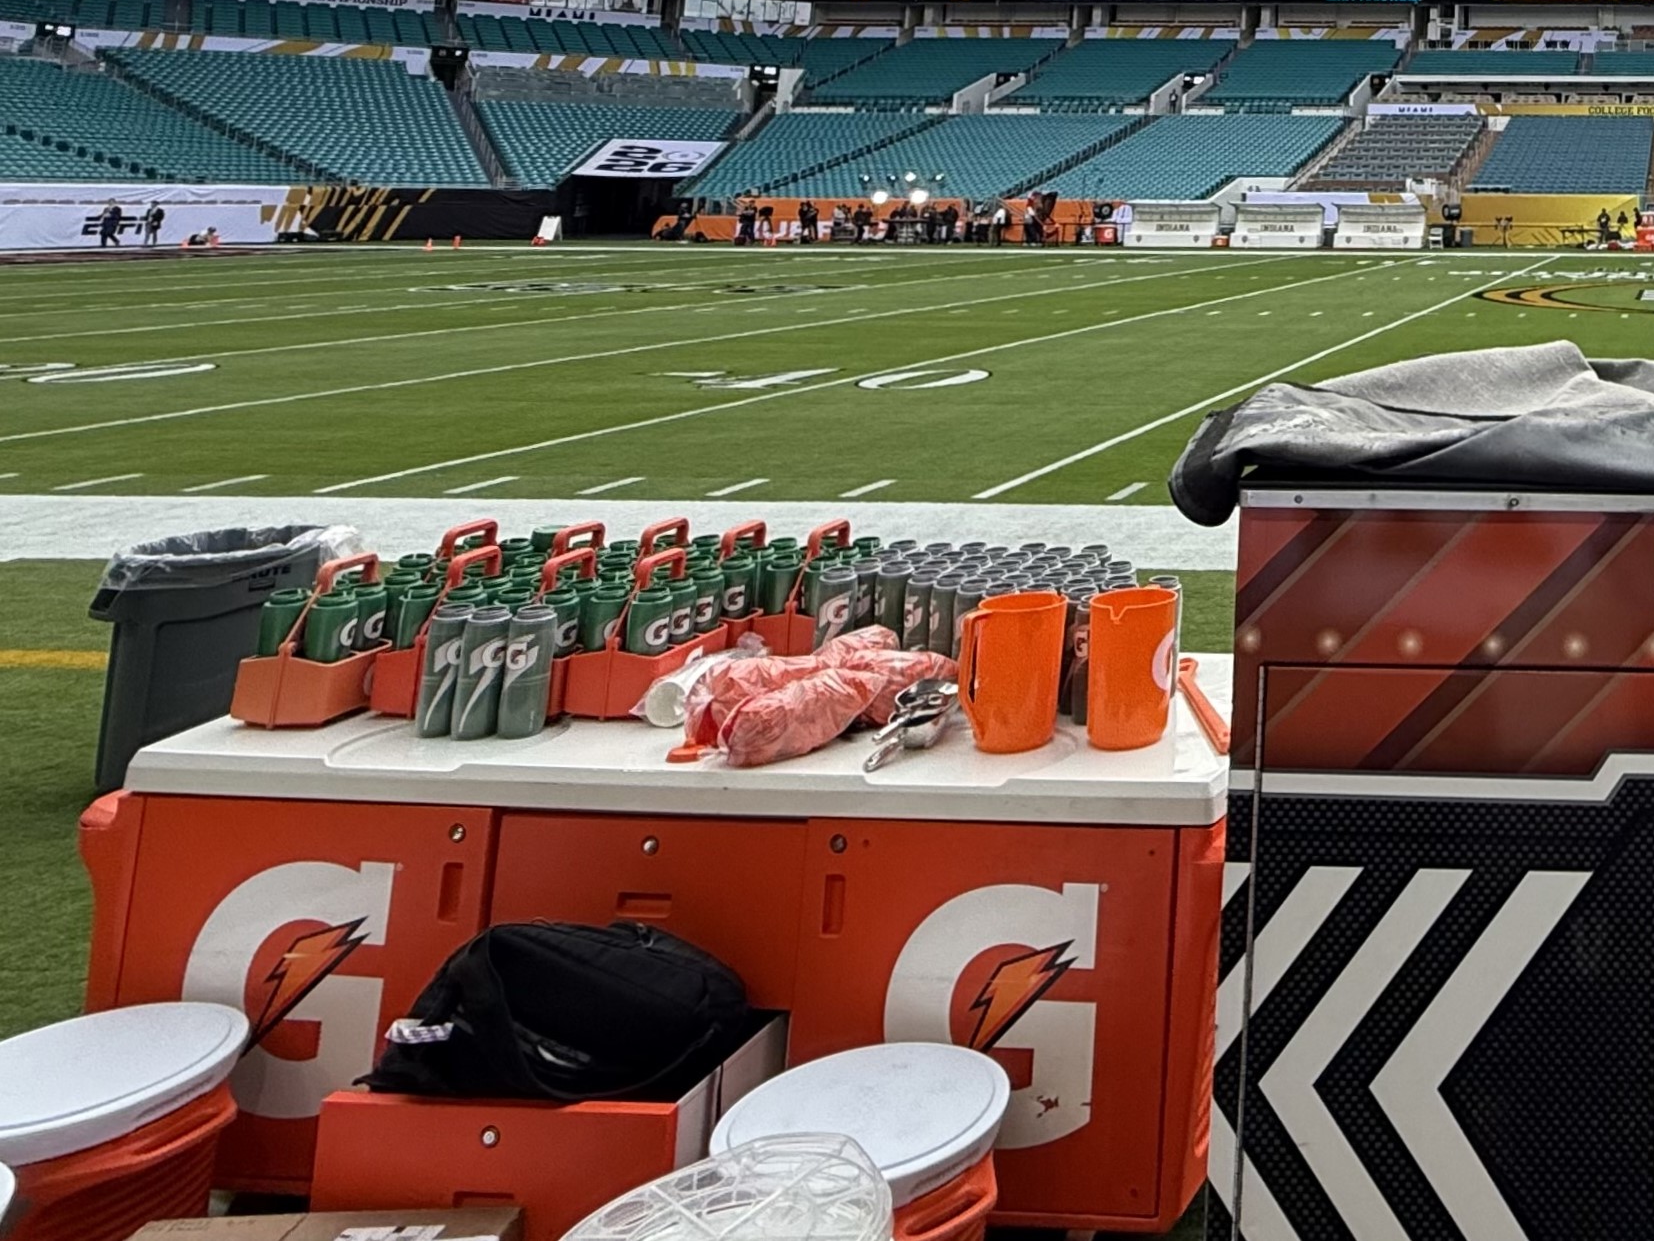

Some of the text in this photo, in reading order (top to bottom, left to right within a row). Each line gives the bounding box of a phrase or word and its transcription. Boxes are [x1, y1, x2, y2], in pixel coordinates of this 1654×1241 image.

[1588, 105, 1633, 118] COLLEGE
[1155, 223, 1191, 233] INDIANA
[1260, 223, 1296, 234] INDIANA
[1362, 223, 1398, 234] INDIANA
[642, 617, 669, 648] G
[668, 606, 691, 636] G
[506, 641, 528, 671] G
[181, 860, 396, 1120] G
[883, 881, 1101, 1151] G
